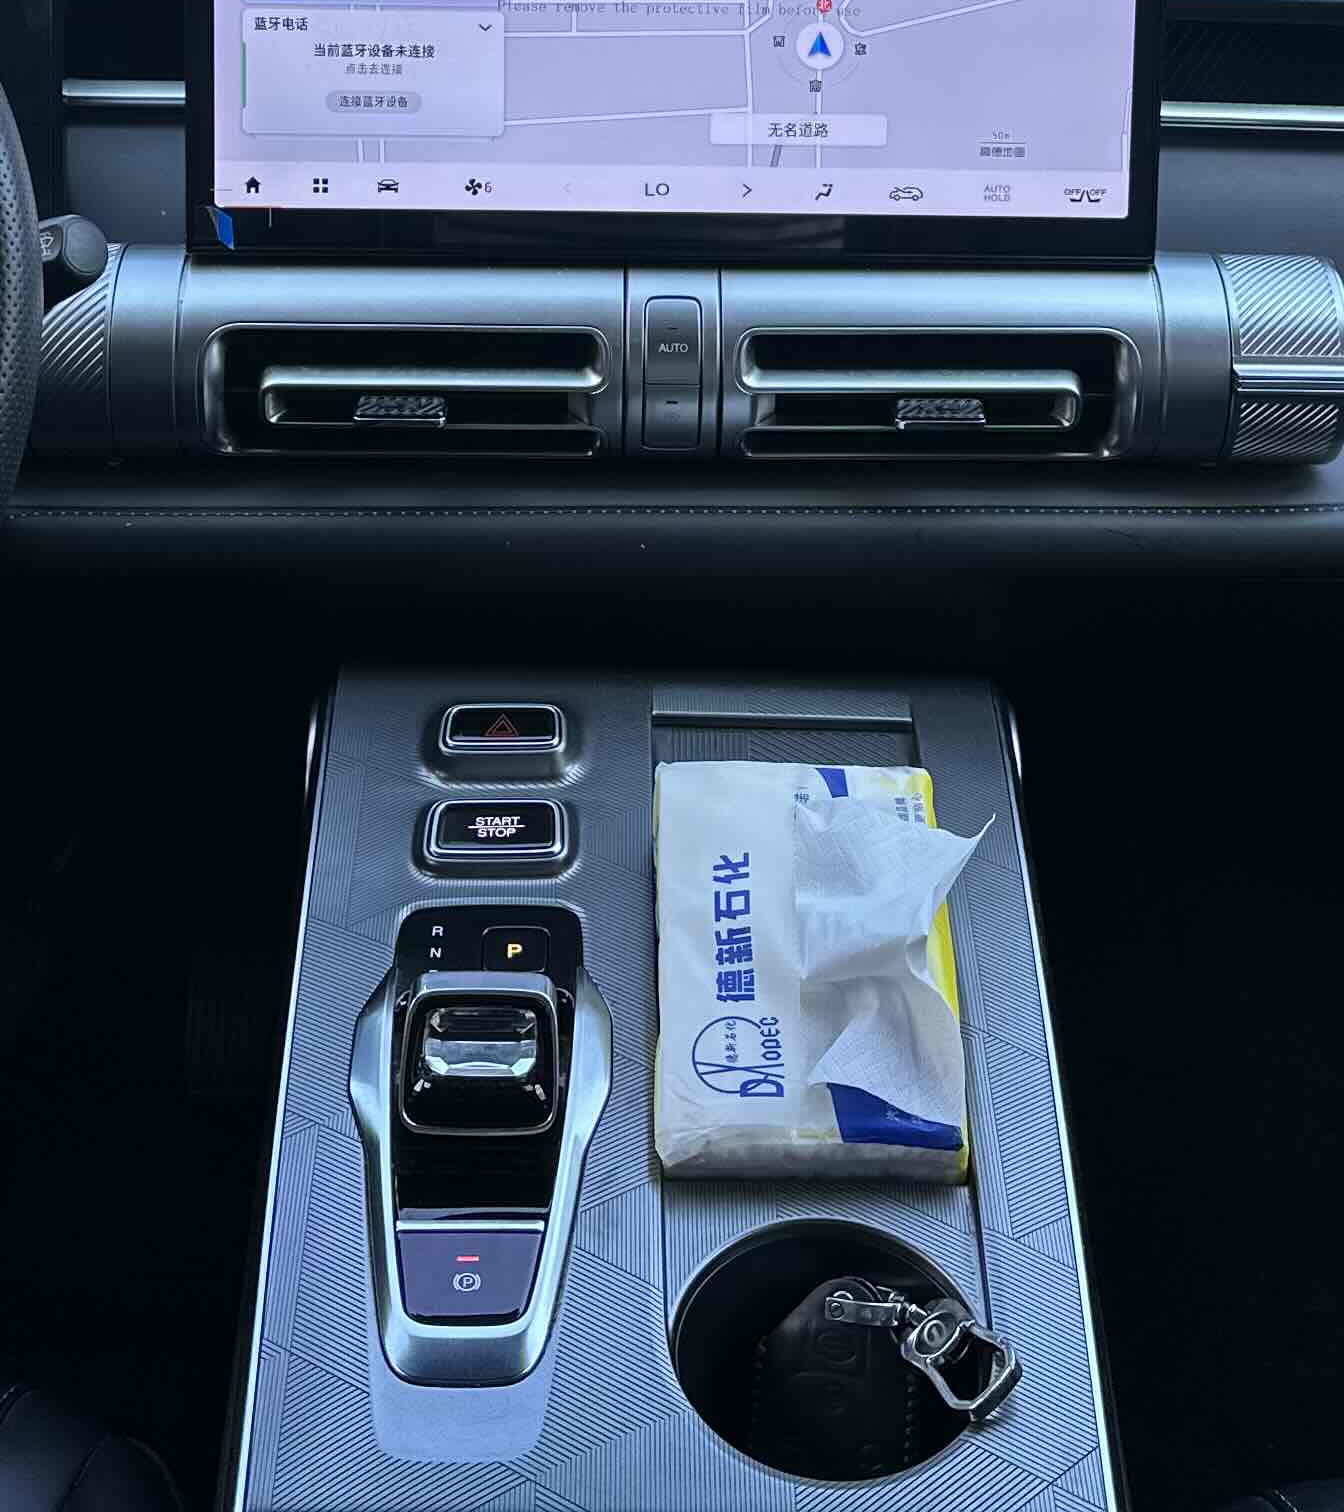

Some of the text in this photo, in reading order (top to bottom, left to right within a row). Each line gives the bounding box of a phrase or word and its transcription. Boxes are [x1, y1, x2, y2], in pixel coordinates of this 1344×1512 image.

[555, 1, 607, 14] remove
[614, 0, 639, 14] the
[645, 1, 729, 17] protective
[737, 0, 772, 17] film
[254, 16, 309, 31] 蓝牙电话
[313, 43, 435, 58] 当前蓝牙设备未连接
[344, 62, 403, 75] 点击去连接
[338, 94, 408, 108] 连接蓝牙设备
[768, 122, 829, 138] 无名道路
[483, 181, 493, 193] 6
[645, 183, 670, 196] LO
[984, 184, 1011, 193] AUTO
[984, 194, 1011, 202] HOLD
[658, 342, 689, 354] AUTO
[475, 816, 521, 827] START
[477, 827, 517, 838] STOP
[431, 925, 444, 937] R
[712, 851, 756, 1003] 德新石化
[429, 947, 442, 959] N
[507, 943, 523, 959] P
